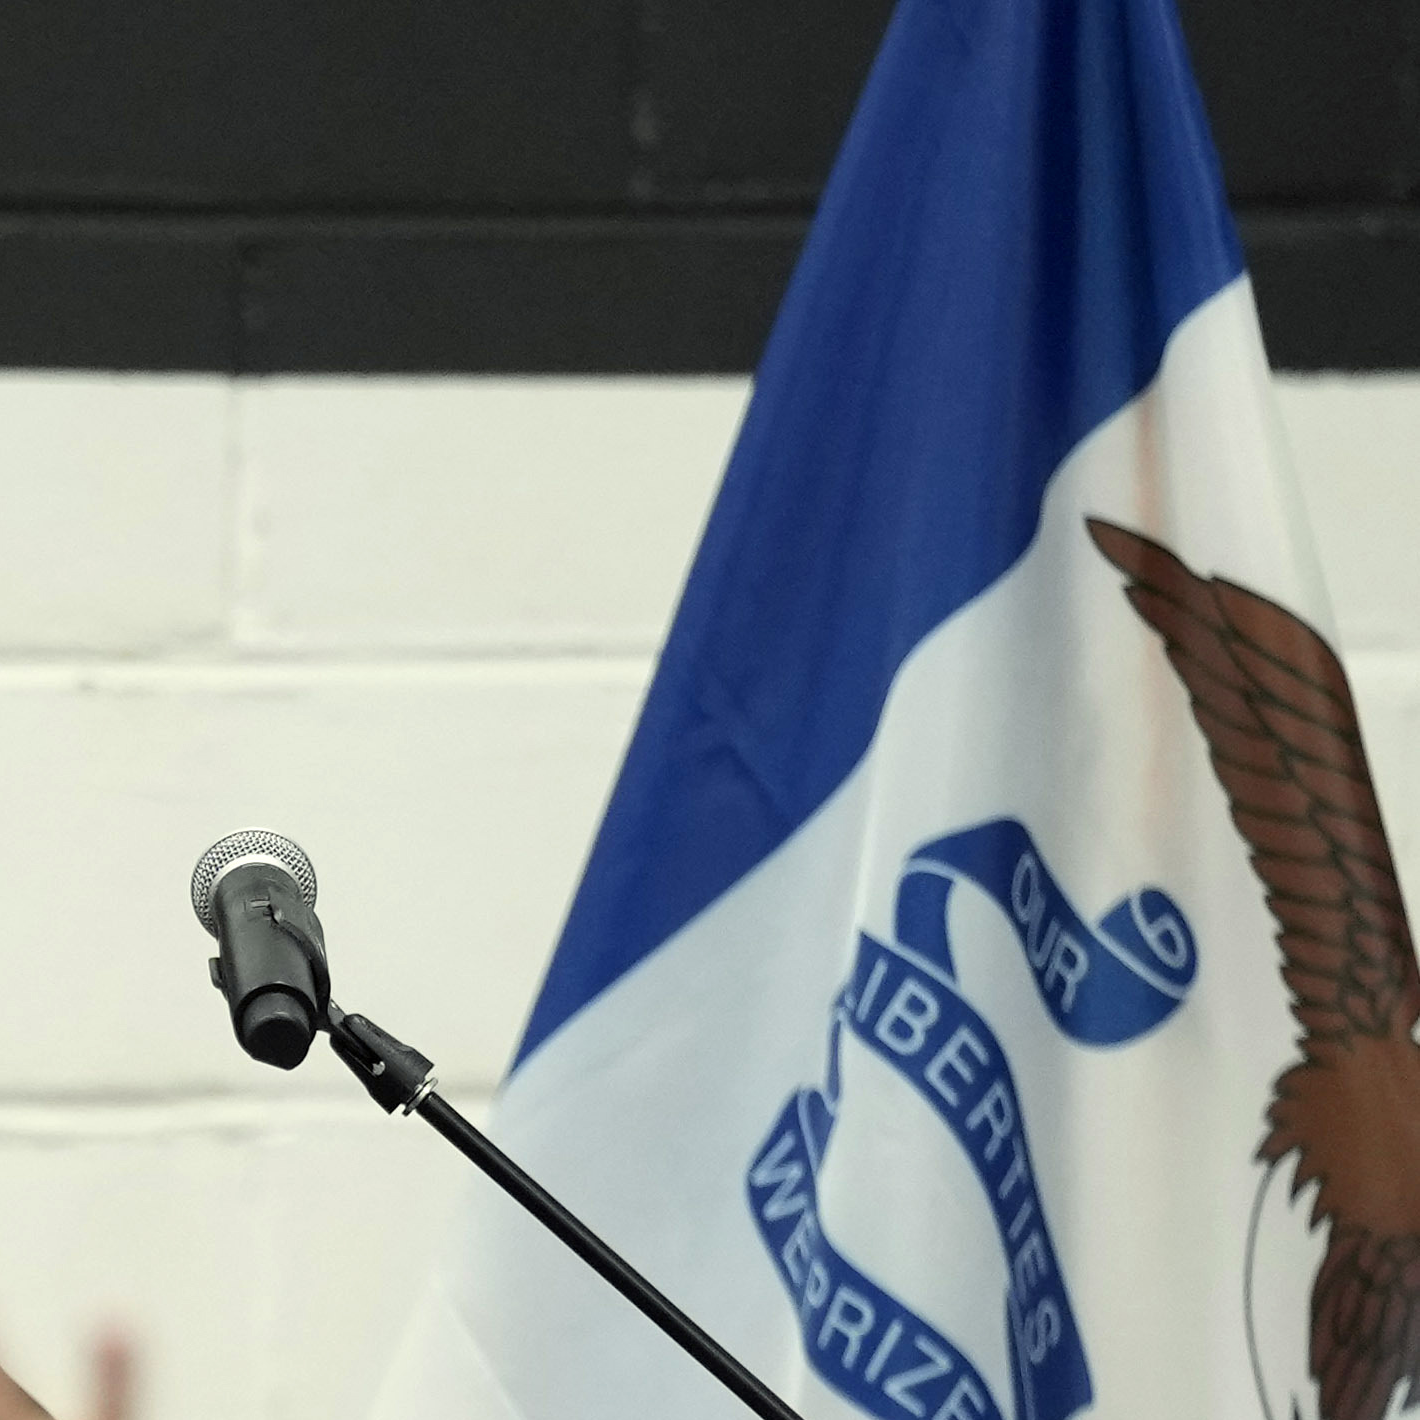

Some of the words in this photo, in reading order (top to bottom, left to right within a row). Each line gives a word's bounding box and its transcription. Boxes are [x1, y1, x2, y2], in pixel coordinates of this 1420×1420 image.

[1010, 852, 1090, 1013] OUR
[749, 1130, 815, 1290] WE
[845, 957, 1061, 1365] IBERTIES
